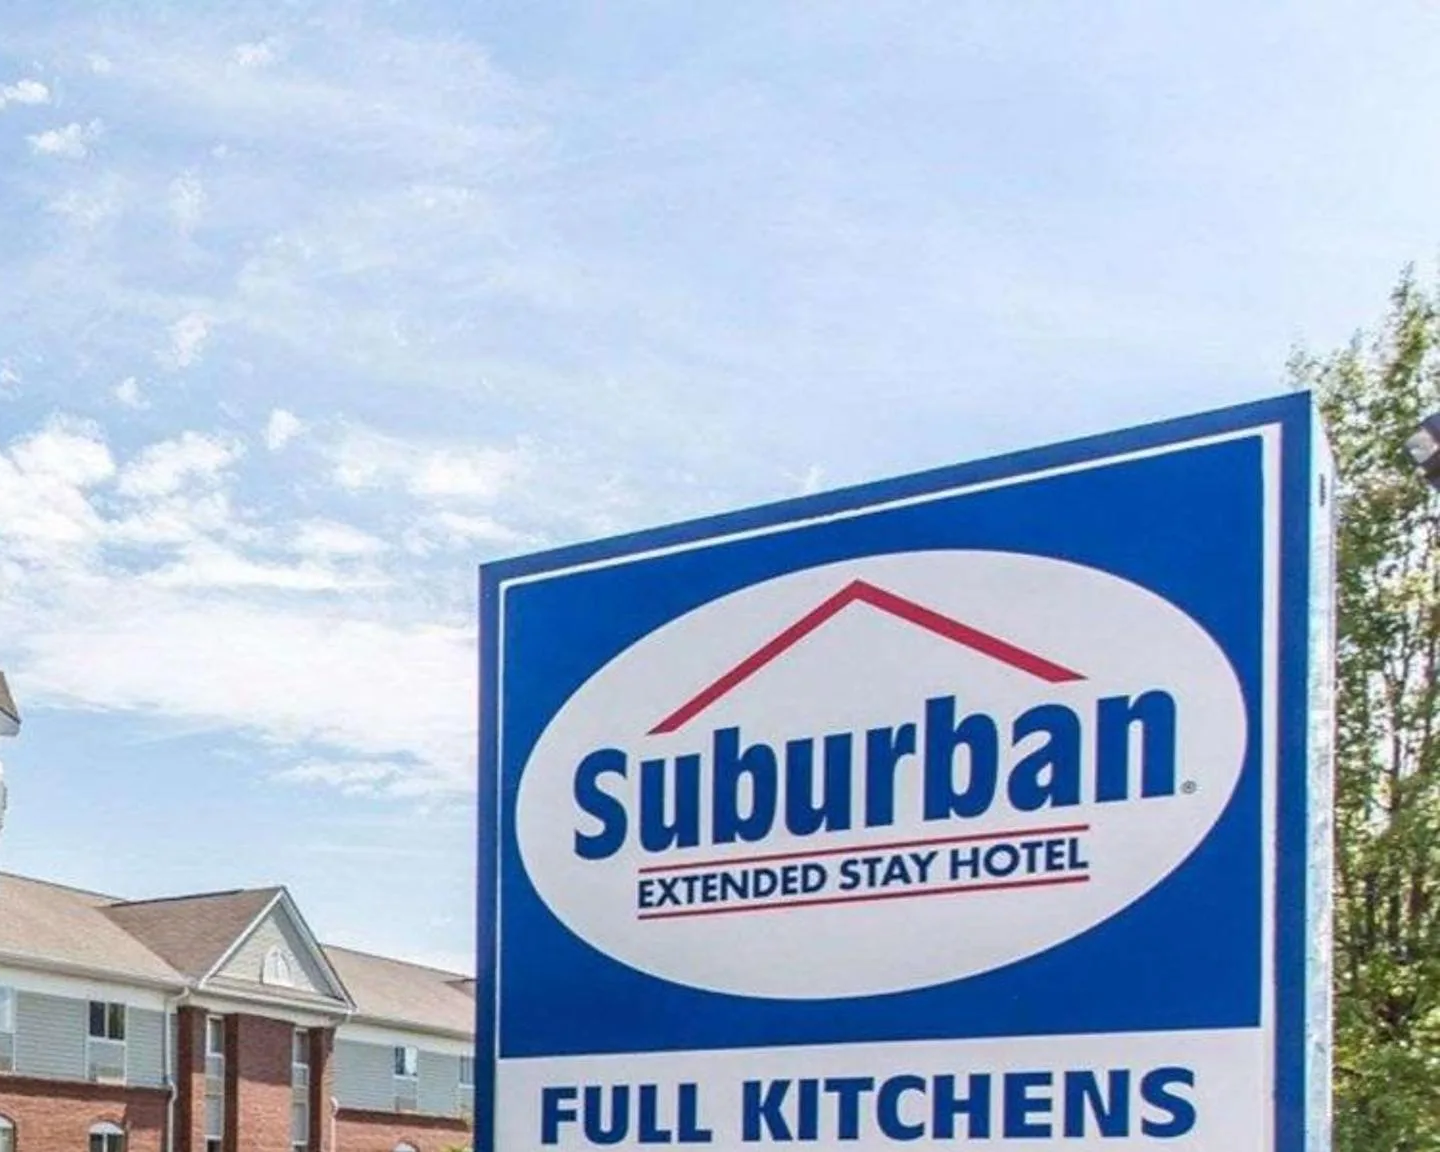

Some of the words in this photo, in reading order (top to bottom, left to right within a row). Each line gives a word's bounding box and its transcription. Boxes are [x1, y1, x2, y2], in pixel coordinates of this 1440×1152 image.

[573, 688, 1177, 861] Suburban
[638, 863, 828, 909] EXTENDED
[838, 850, 939, 891] STAY
[949, 837, 1089, 881] HOTEL
[540, 1083, 713, 1146] FULL
[741, 1066, 1197, 1143] KITCHENS
